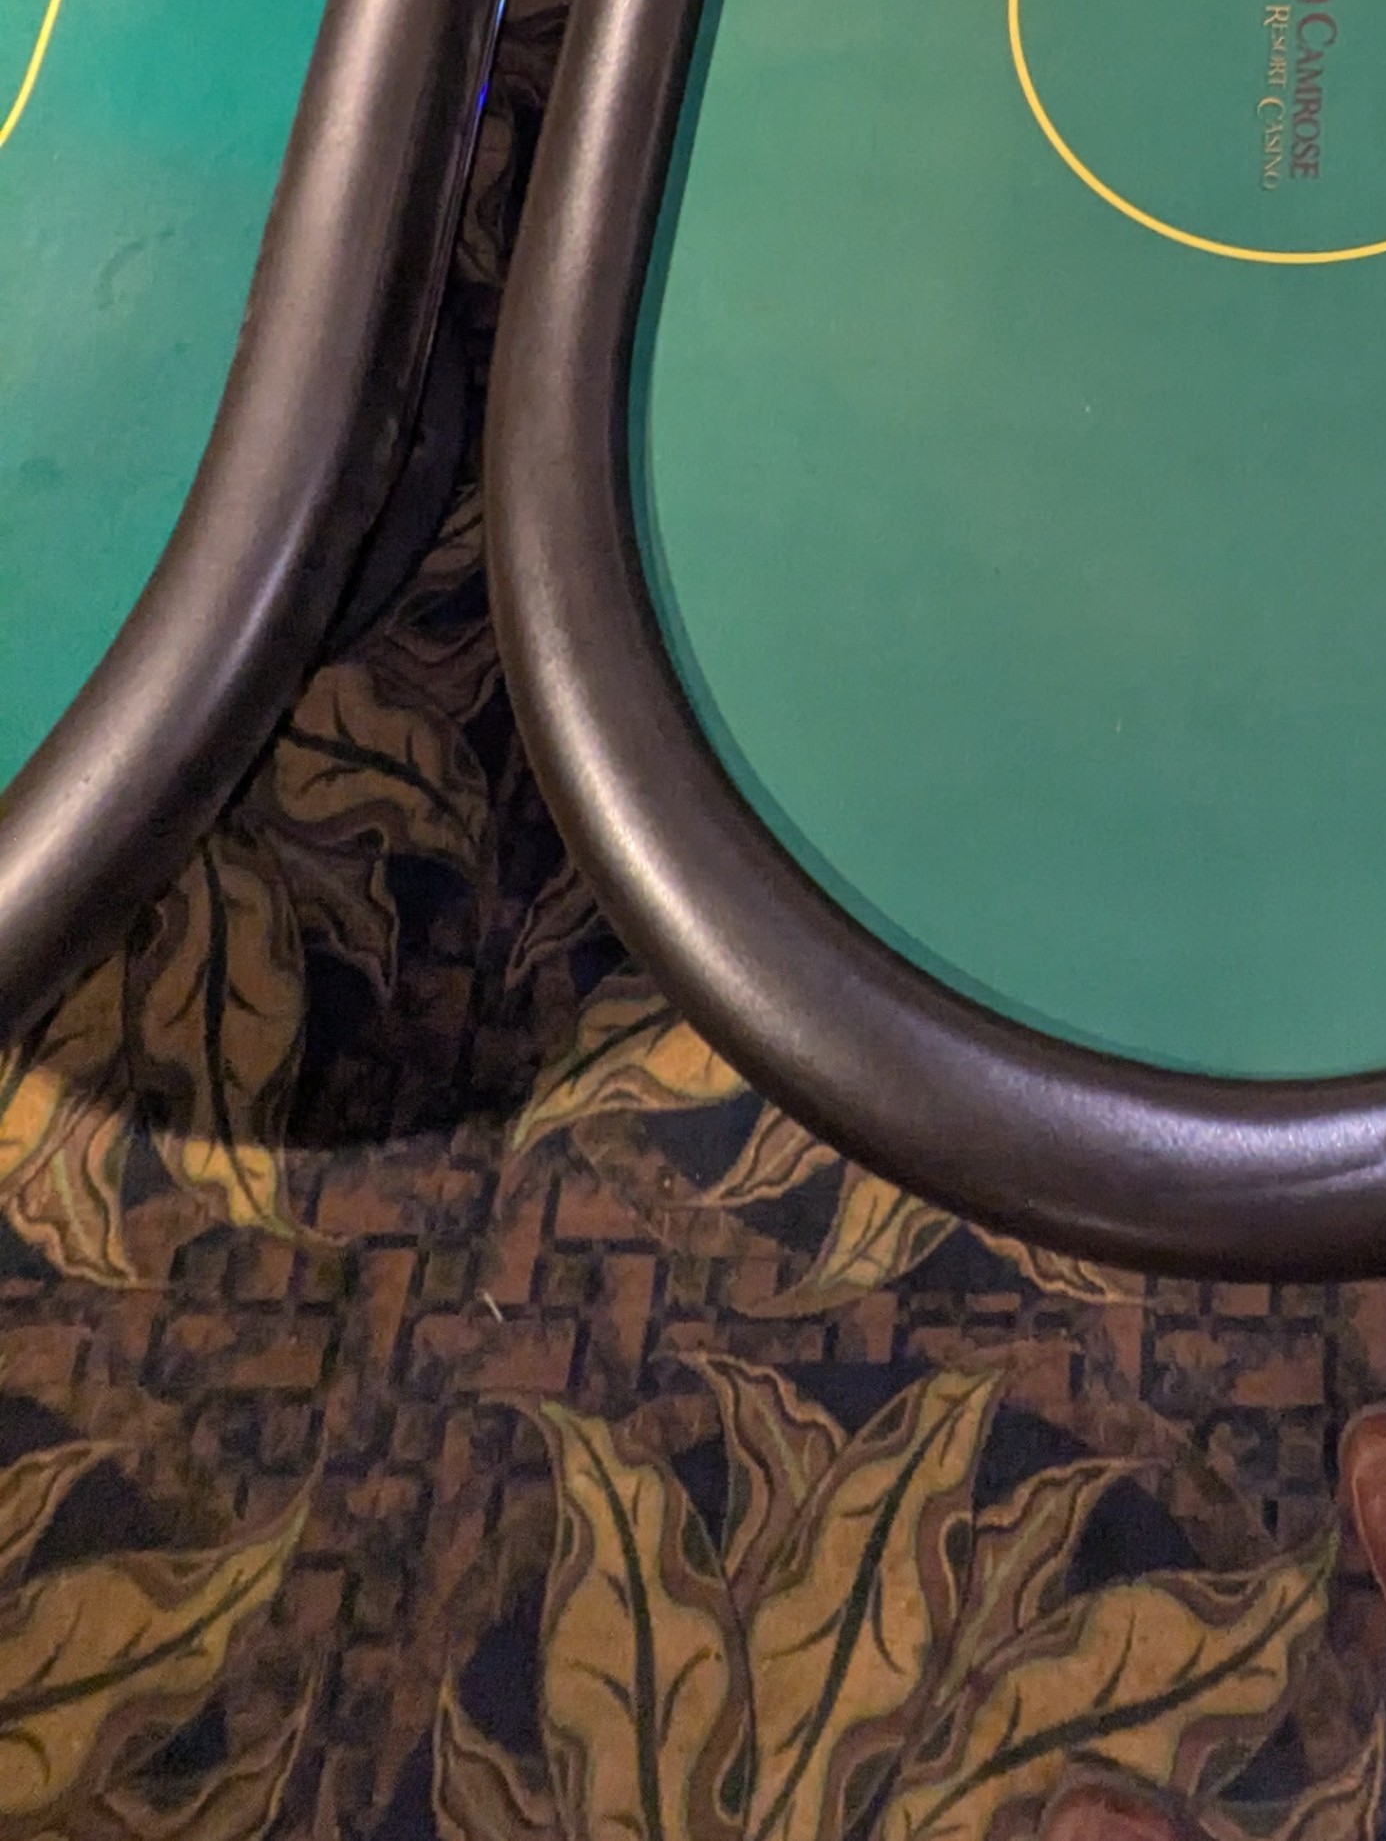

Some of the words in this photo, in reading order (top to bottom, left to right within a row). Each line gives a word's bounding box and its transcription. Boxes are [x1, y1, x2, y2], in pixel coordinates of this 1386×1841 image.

[1263, 5, 1291, 88] RESORT
[1257, 95, 1286, 190] CASINO
[1290, 13, 1338, 179] CAMROSE
